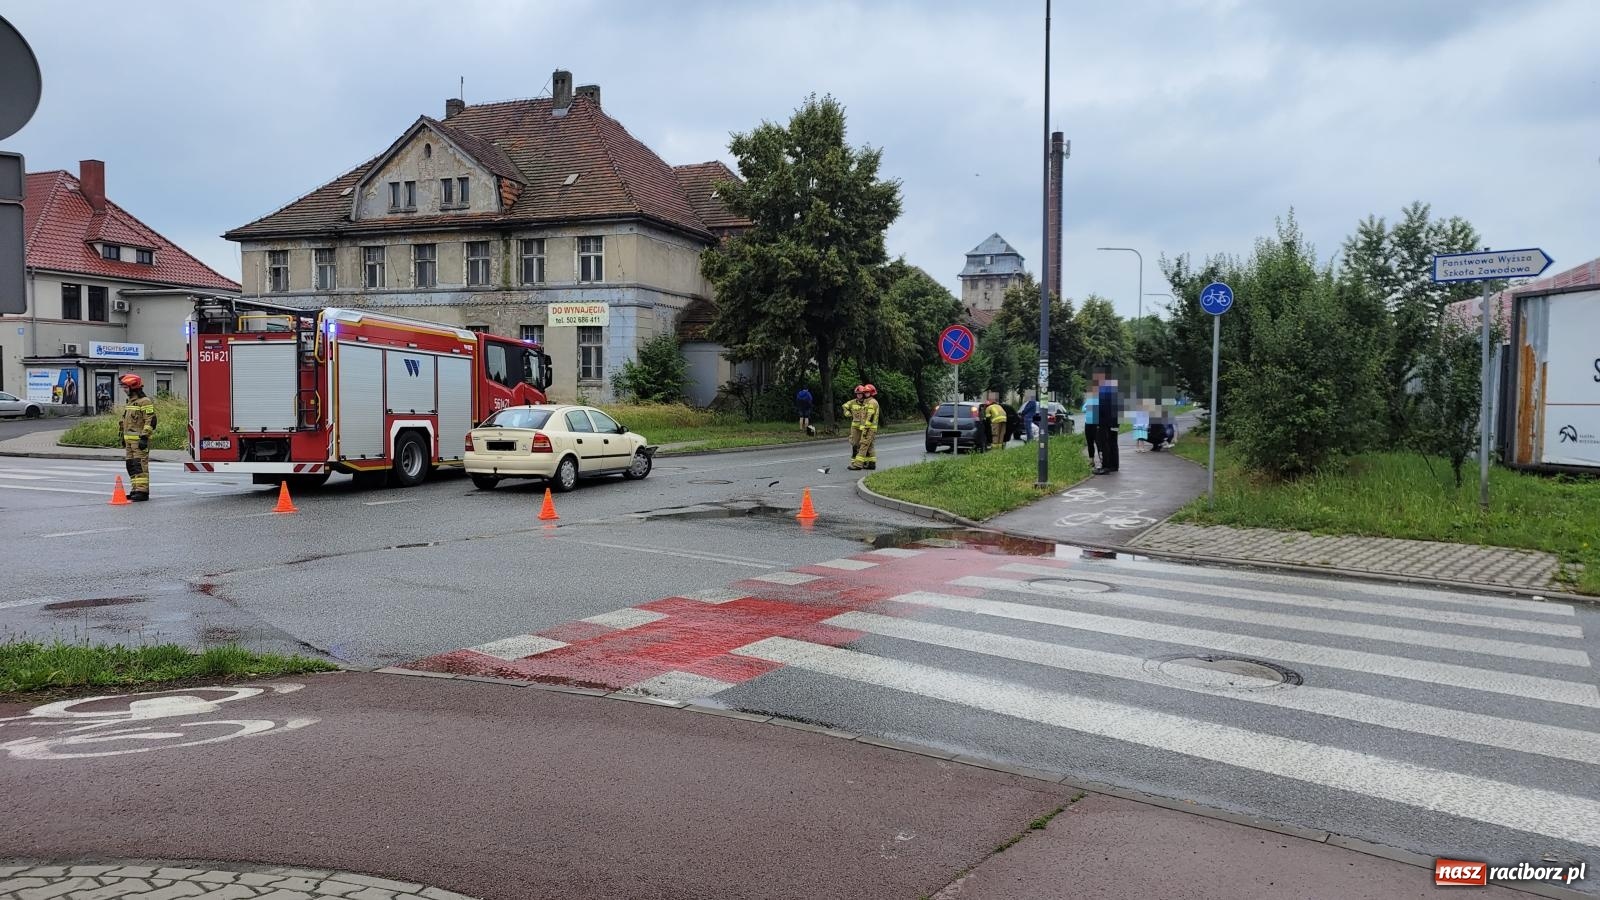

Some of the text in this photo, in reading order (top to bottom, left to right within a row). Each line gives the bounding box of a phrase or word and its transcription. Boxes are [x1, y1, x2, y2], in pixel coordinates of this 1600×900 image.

[1478, 267, 1531, 275] Zawodowa
[552, 306, 606, 315] DO WYNAJĘCIA
[566, 316, 577, 324] 502
